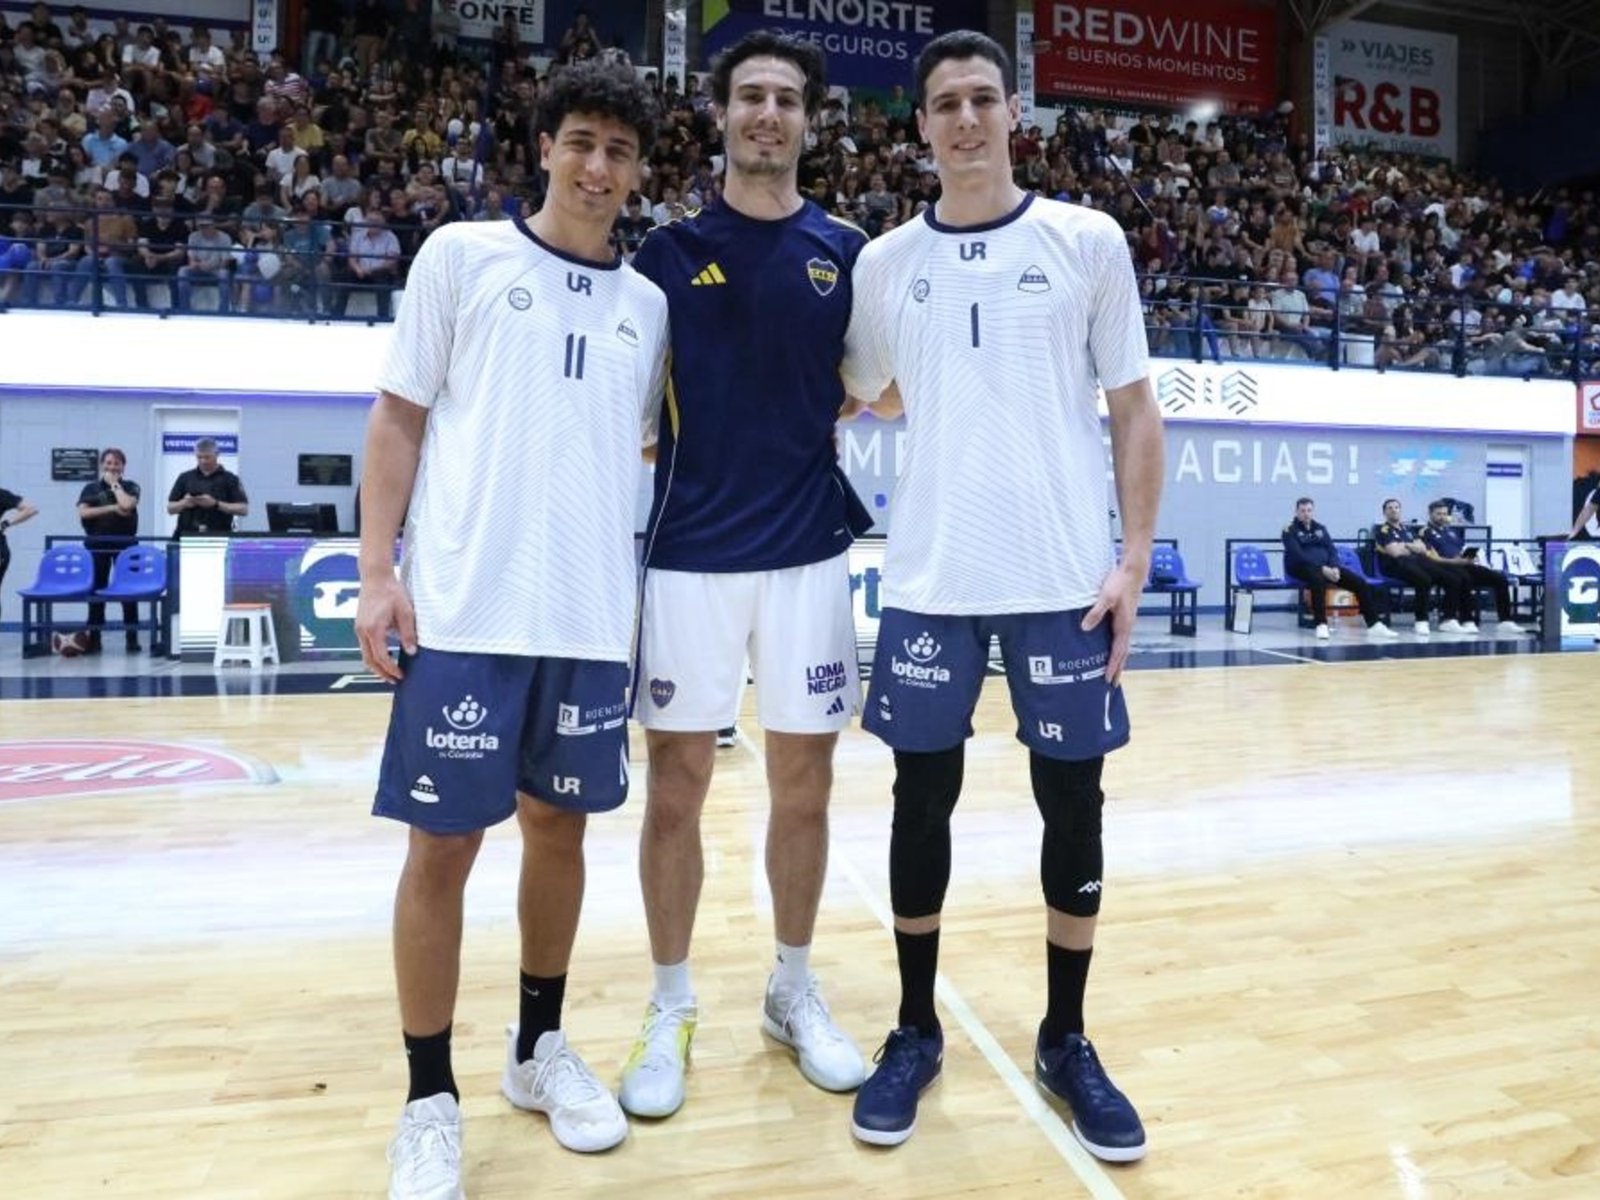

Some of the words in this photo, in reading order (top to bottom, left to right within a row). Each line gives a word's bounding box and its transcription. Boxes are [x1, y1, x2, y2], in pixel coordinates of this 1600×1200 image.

[1067, 48, 1143, 69] BUENOS
[1147, 57, 1247, 81] MOMENTOS
[1361, 41, 1435, 66] VIAJES
[1334, 75, 1442, 138] R&B
[960, 241, 987, 261] UR
[566, 271, 592, 296] UR
[564, 332, 587, 380] 11
[806, 660, 845, 681] LOMA
[425, 726, 500, 751] lotería
[1038, 719, 1063, 743] UR
[553, 774, 582, 796] UR
